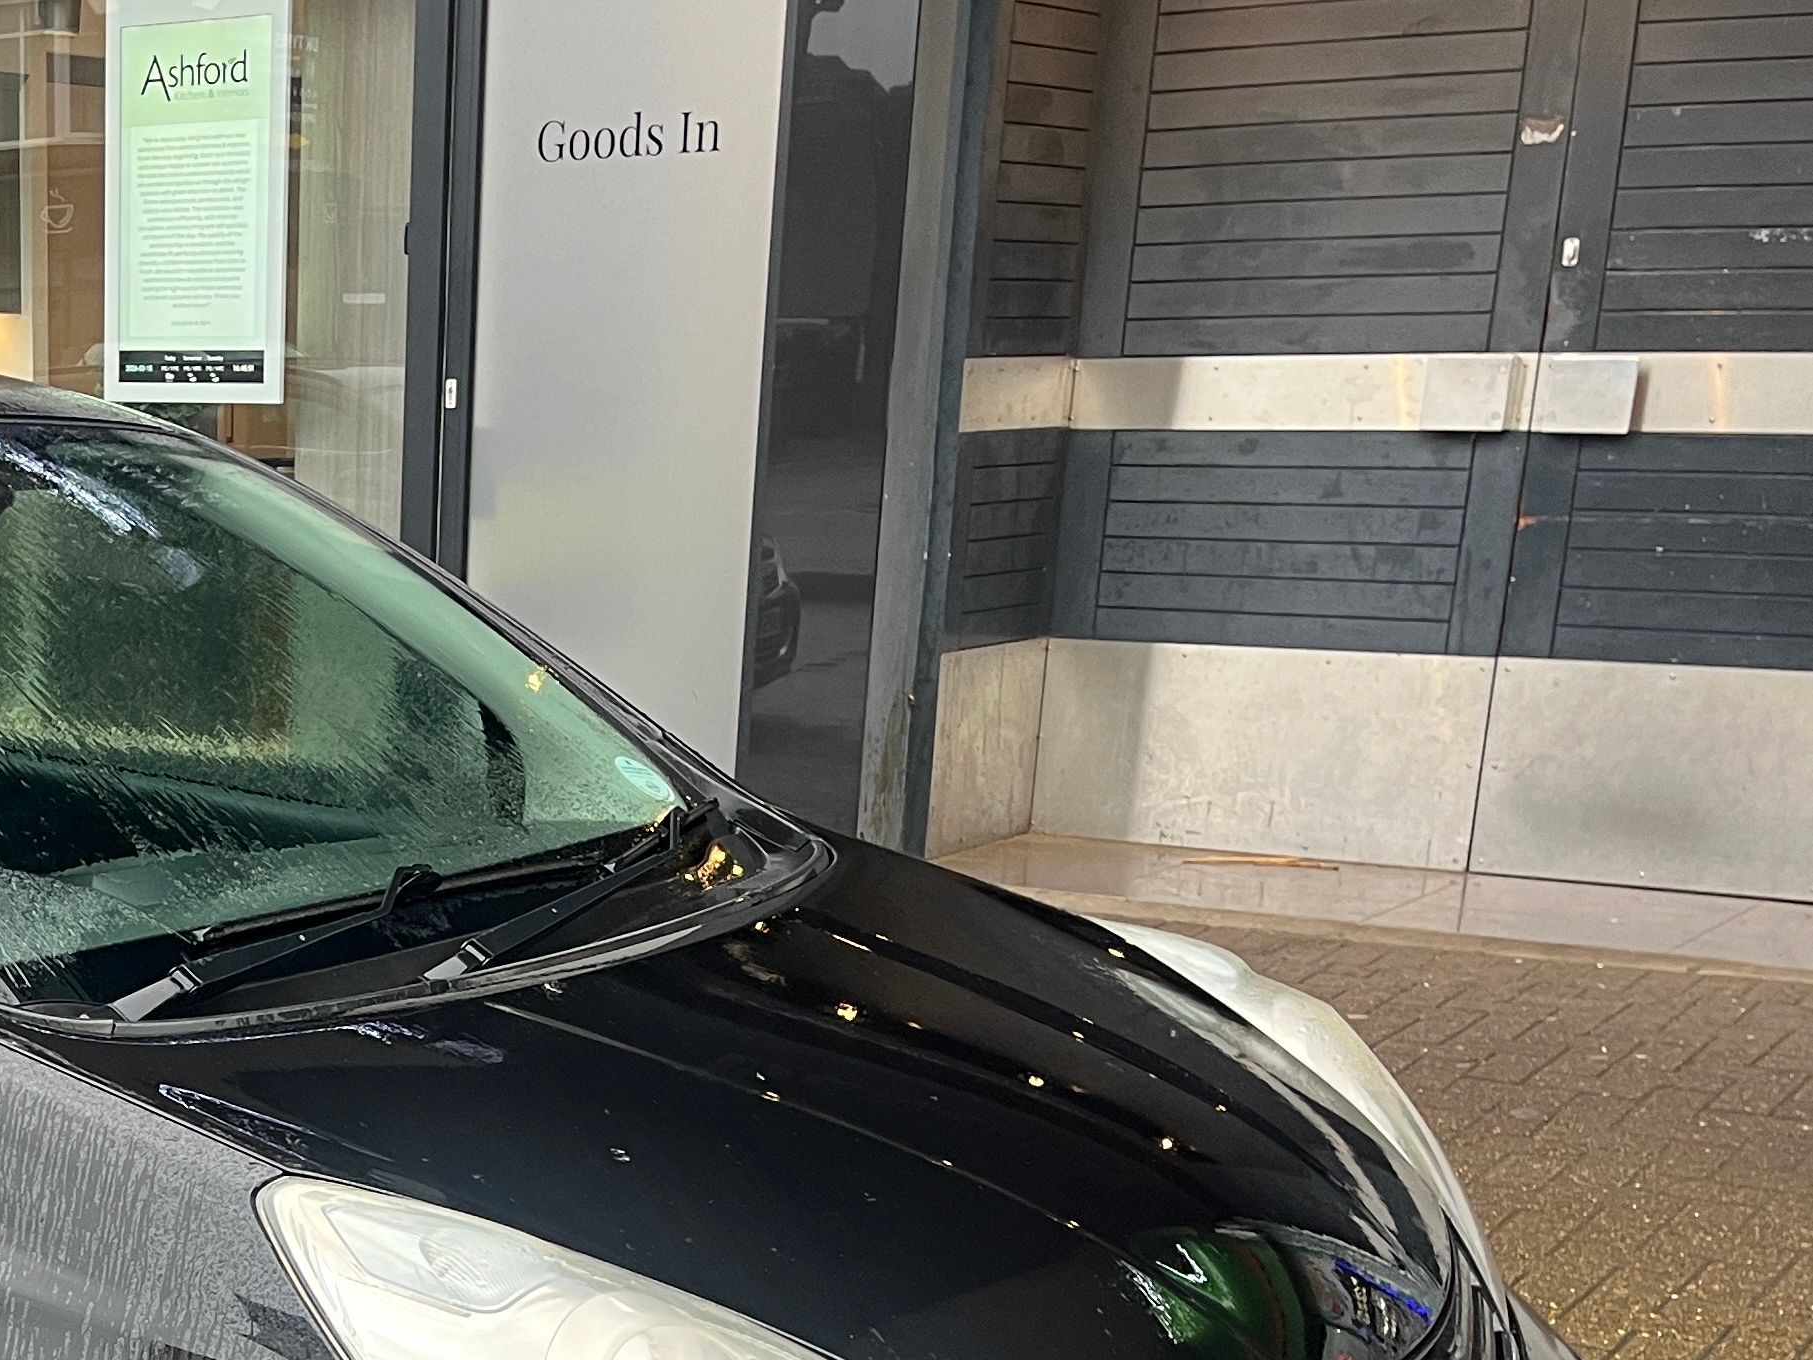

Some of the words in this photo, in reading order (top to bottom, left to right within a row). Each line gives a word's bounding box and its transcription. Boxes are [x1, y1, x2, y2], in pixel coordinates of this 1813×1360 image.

[141, 49, 248, 102] Ashford
[538, 111, 664, 163] Goods
[678, 111, 720, 154] In
